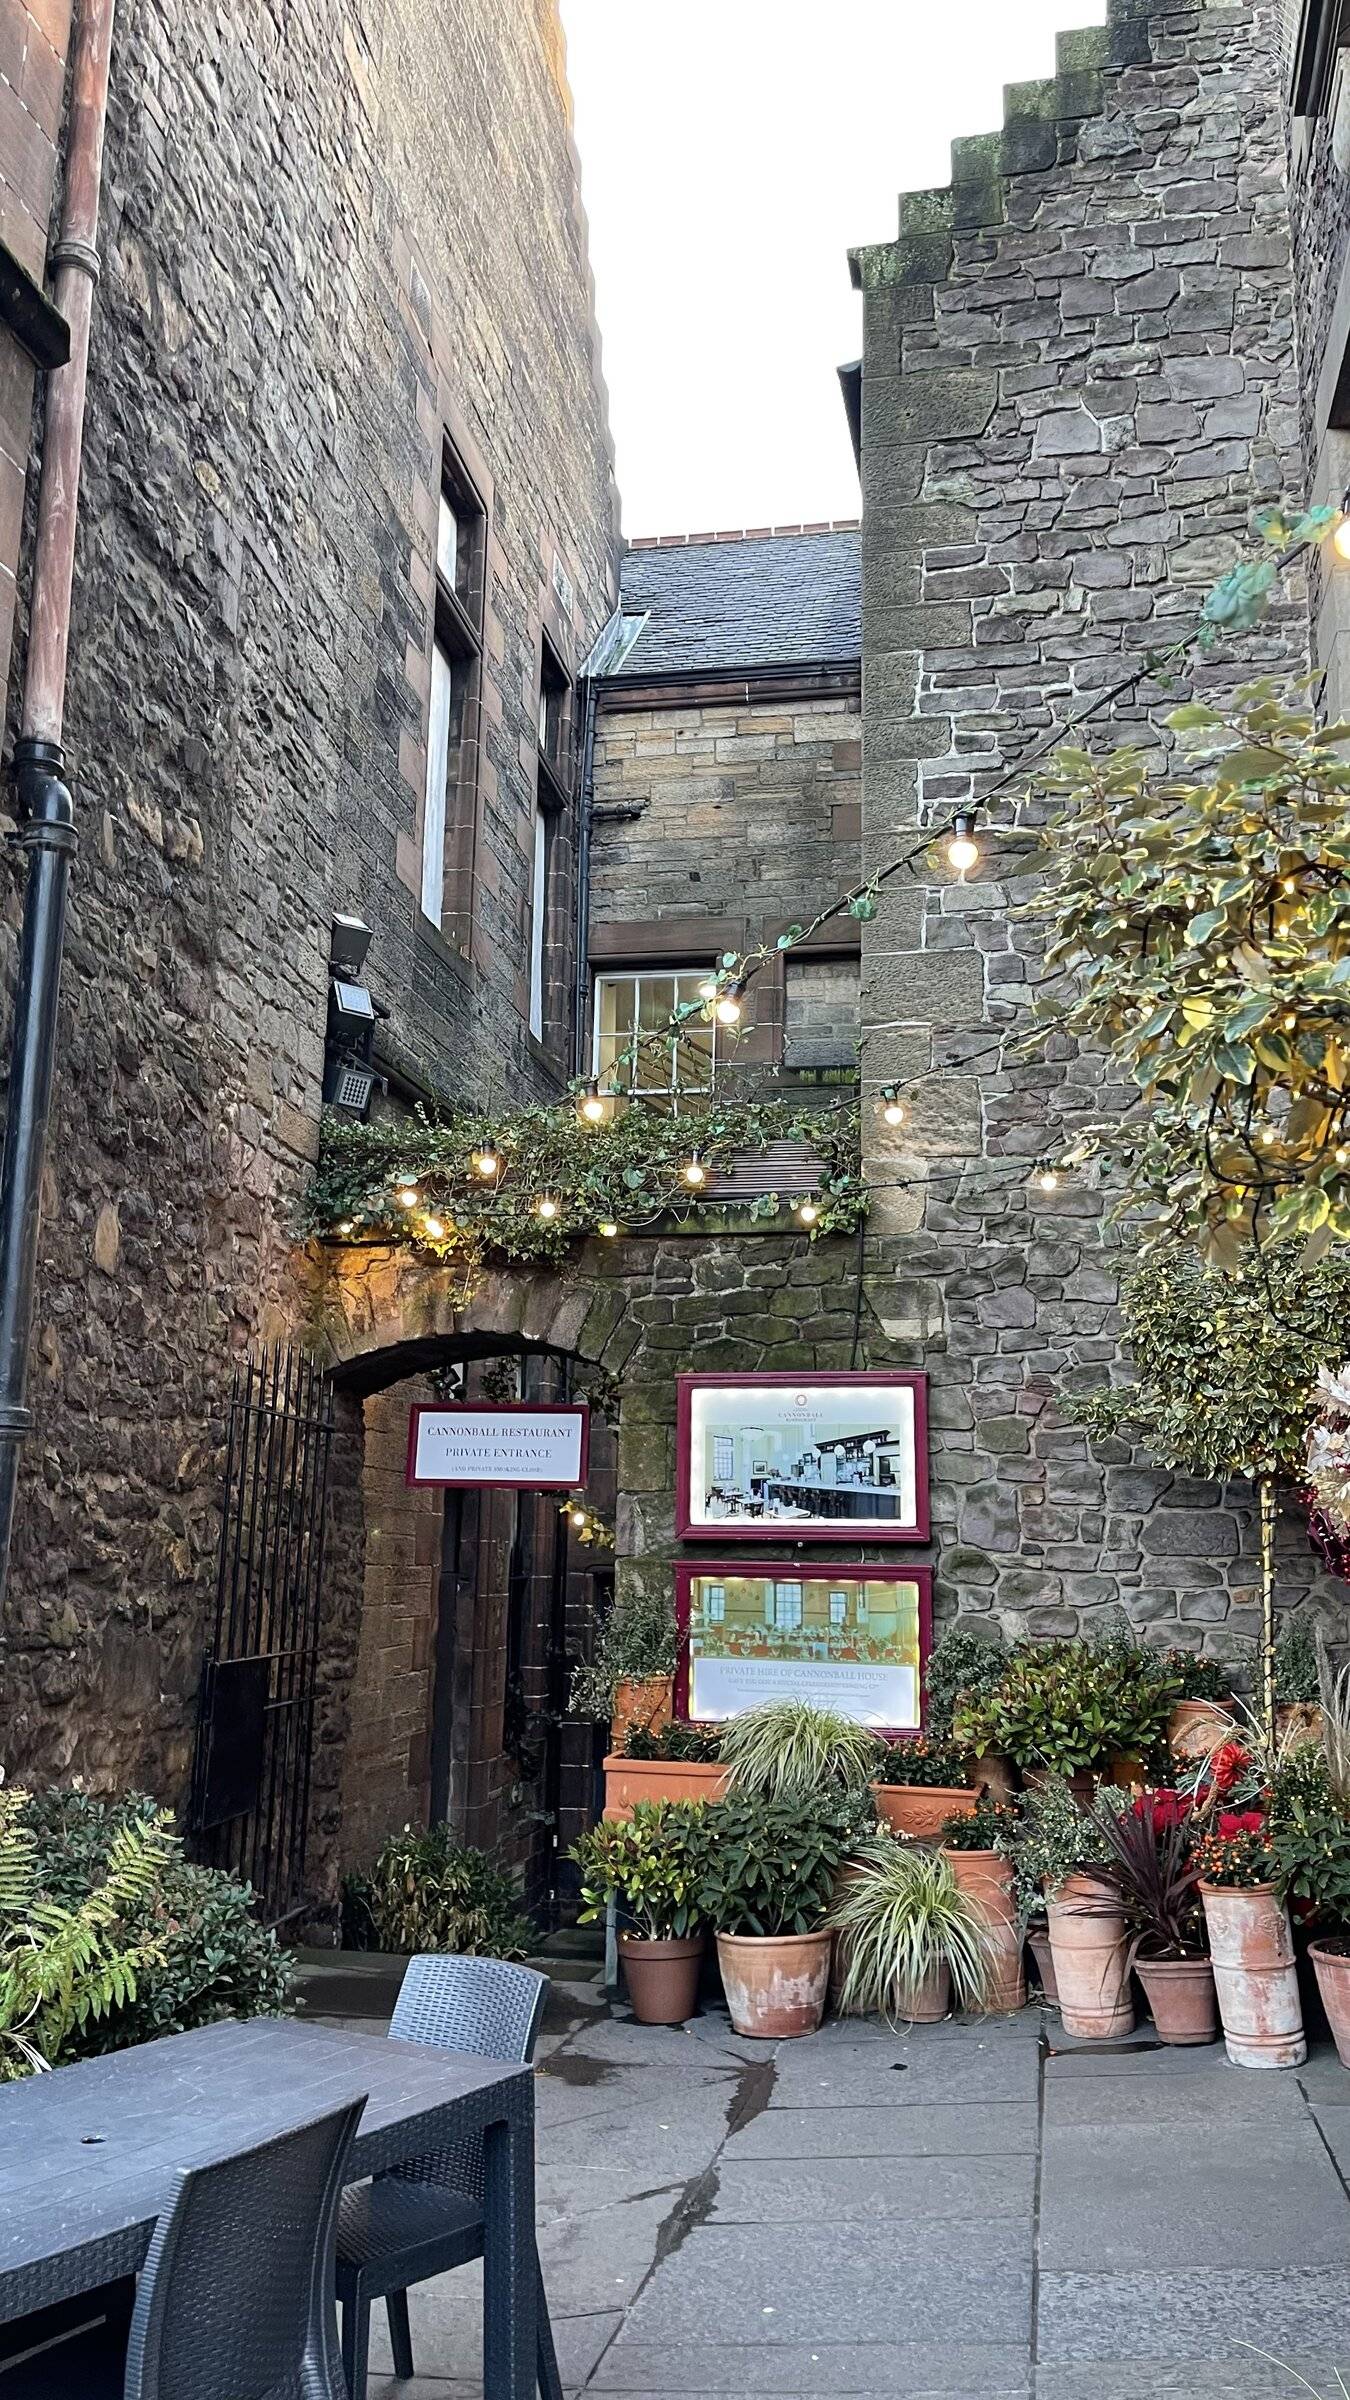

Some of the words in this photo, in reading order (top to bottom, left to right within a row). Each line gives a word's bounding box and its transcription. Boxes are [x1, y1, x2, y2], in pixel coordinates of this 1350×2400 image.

[427, 1427, 499, 1437] CANNONBALL
[501, 1428, 573, 1438] RESTAURANT
[445, 1447, 491, 1457] PRIVATE
[493, 1448, 552, 1459] ENTRANCE
[719, 1666, 756, 1676] PRIVATE
[757, 1667, 779, 1677] HIRE
[780, 1669, 793, 1678] OF
[794, 1669, 857, 1680] CANNONBALL
[857, 1671, 888, 1681] HOUSE
